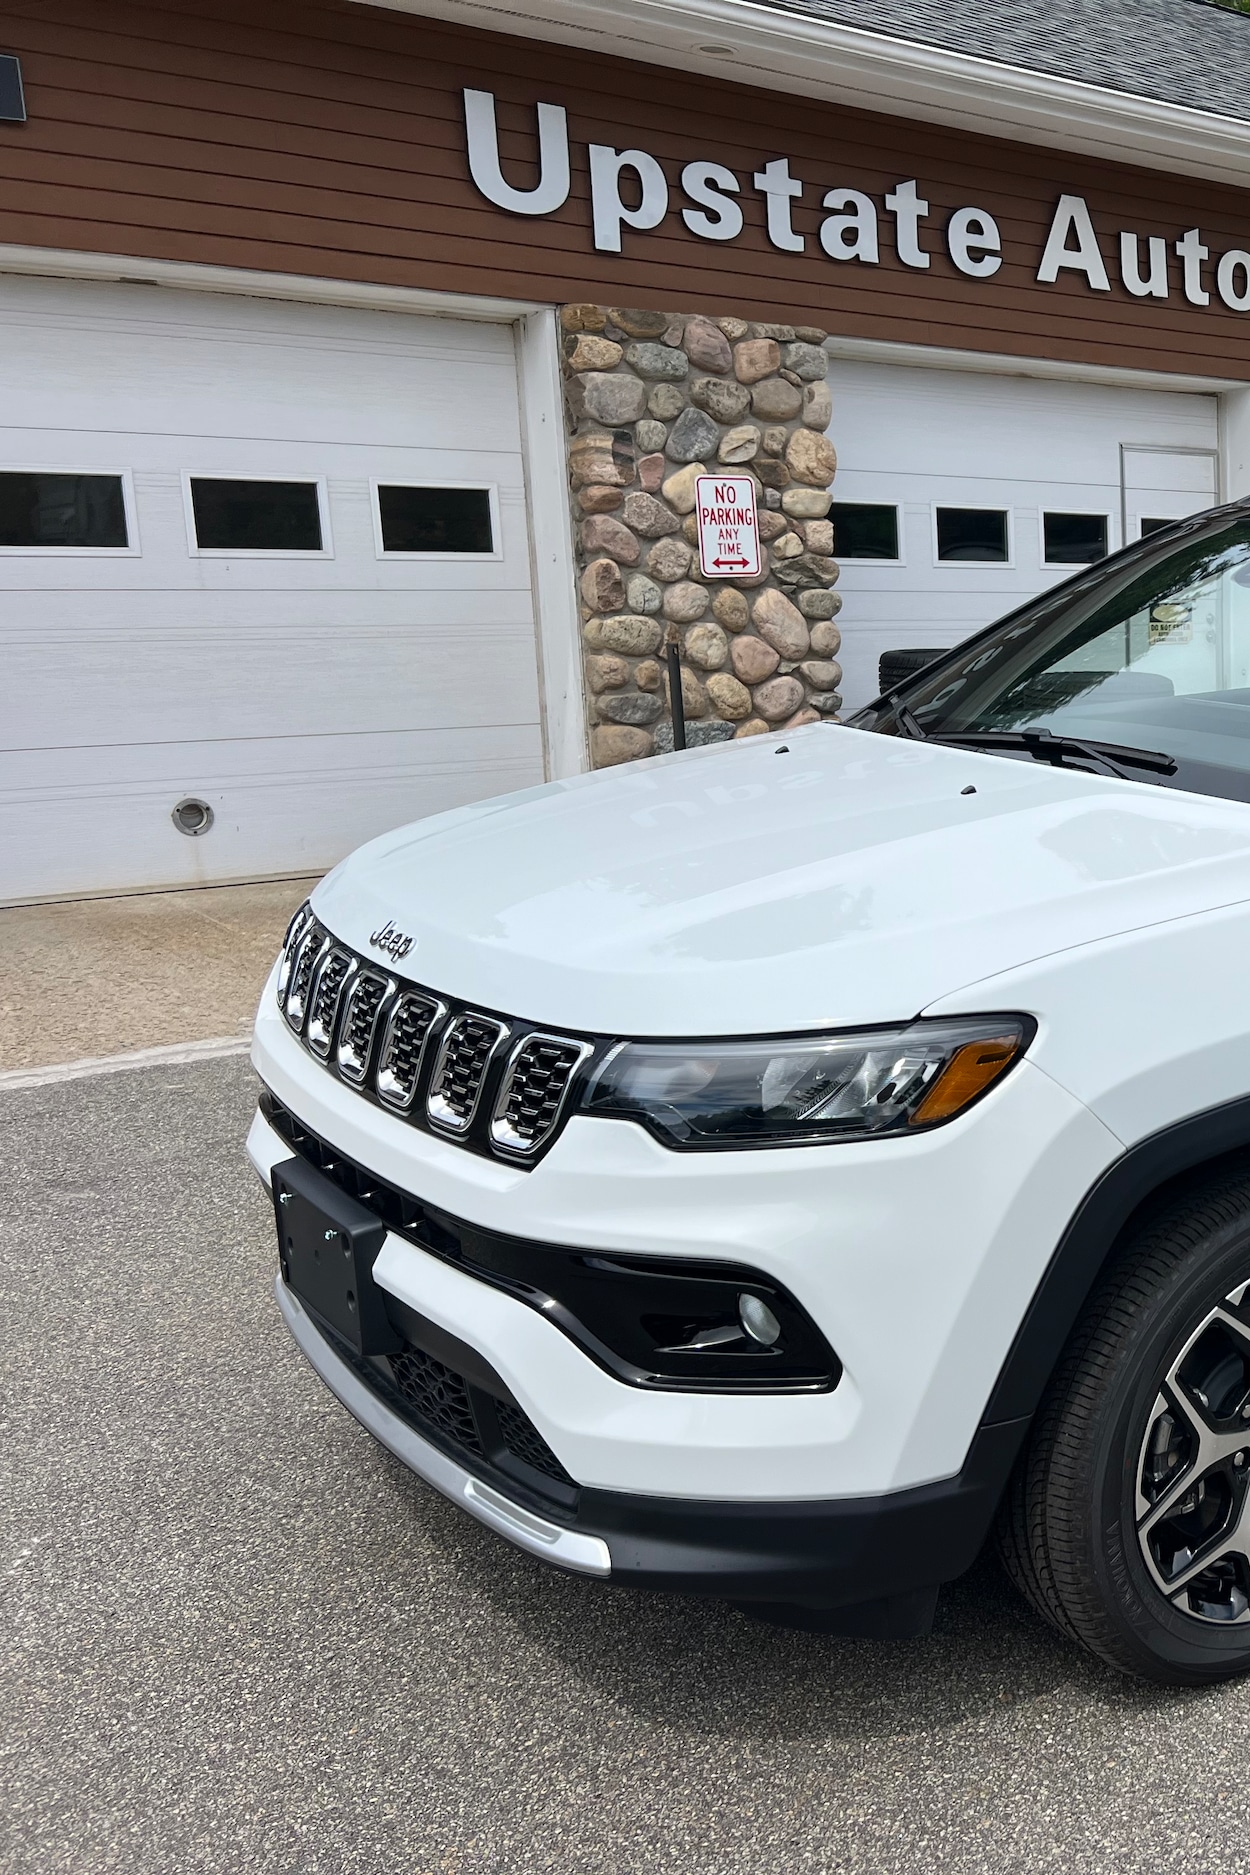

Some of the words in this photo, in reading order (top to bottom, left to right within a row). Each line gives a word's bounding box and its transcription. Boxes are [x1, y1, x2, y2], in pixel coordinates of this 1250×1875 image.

[463, 87, 1004, 279] Upstate
[715, 486, 736, 504] NO
[702, 507, 752, 526] PARKING
[718, 528, 739, 540] ANY
[717, 543, 742, 555] TIME
[369, 920, 417, 964] Jeep
